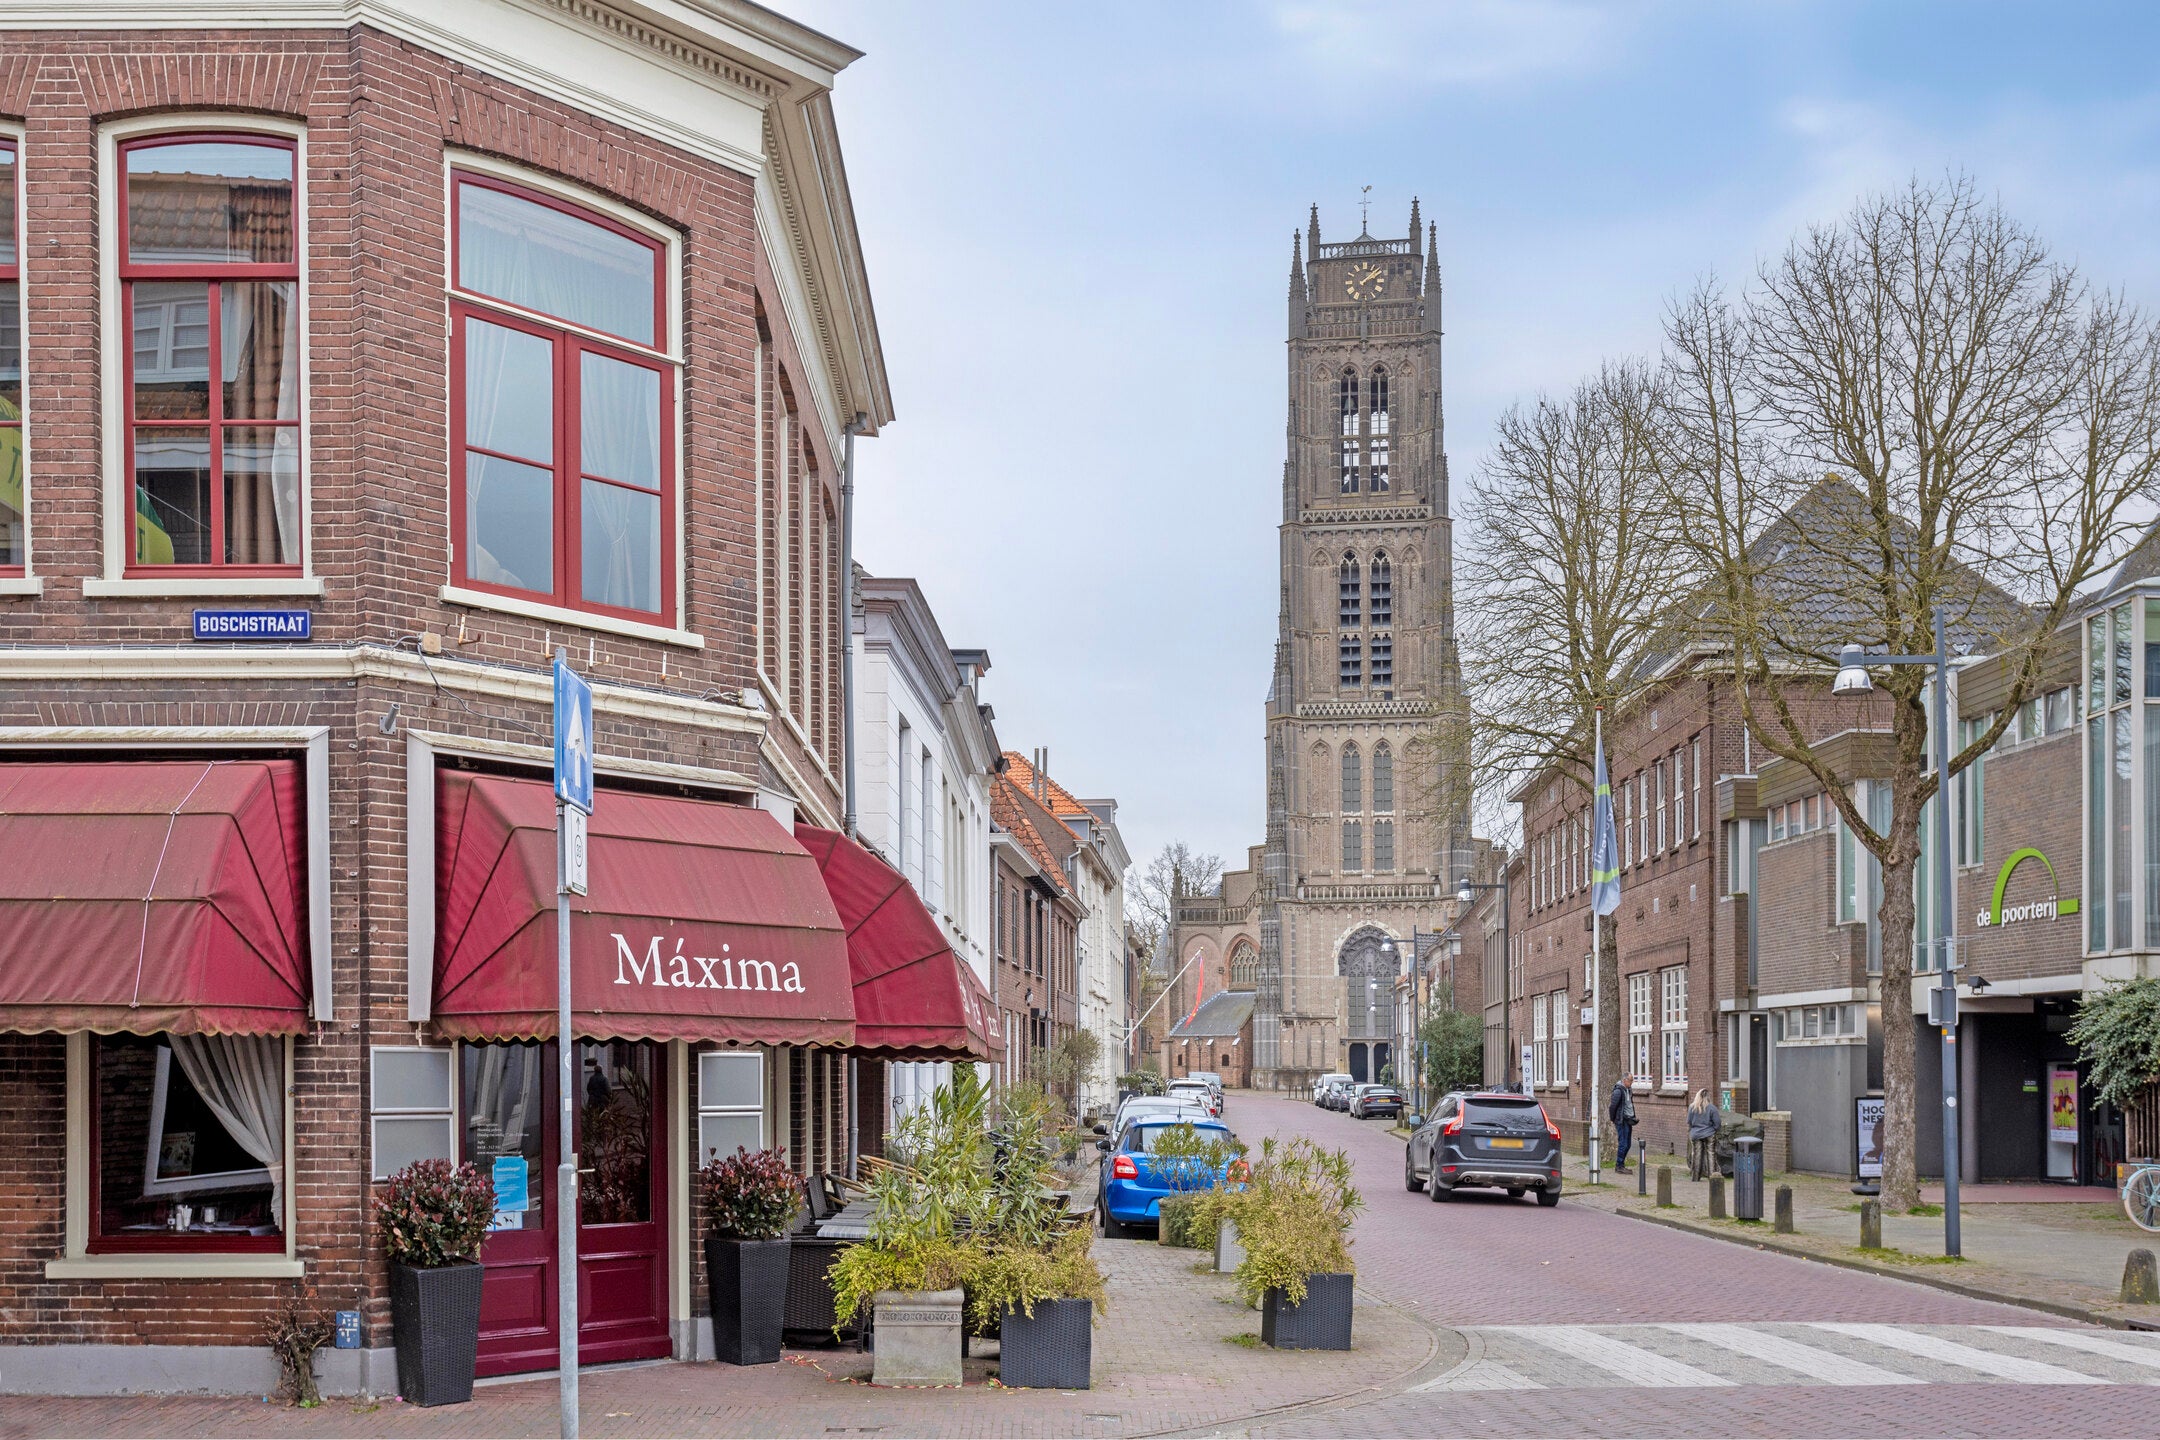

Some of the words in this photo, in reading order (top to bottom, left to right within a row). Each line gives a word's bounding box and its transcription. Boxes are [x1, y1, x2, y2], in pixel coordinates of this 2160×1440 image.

[199, 616, 305, 632] BOSCHSTRAAT
[1976, 907, 1991, 927] de
[2001, 895, 2057, 928] poorterij
[610, 933, 806, 993] Máxima
